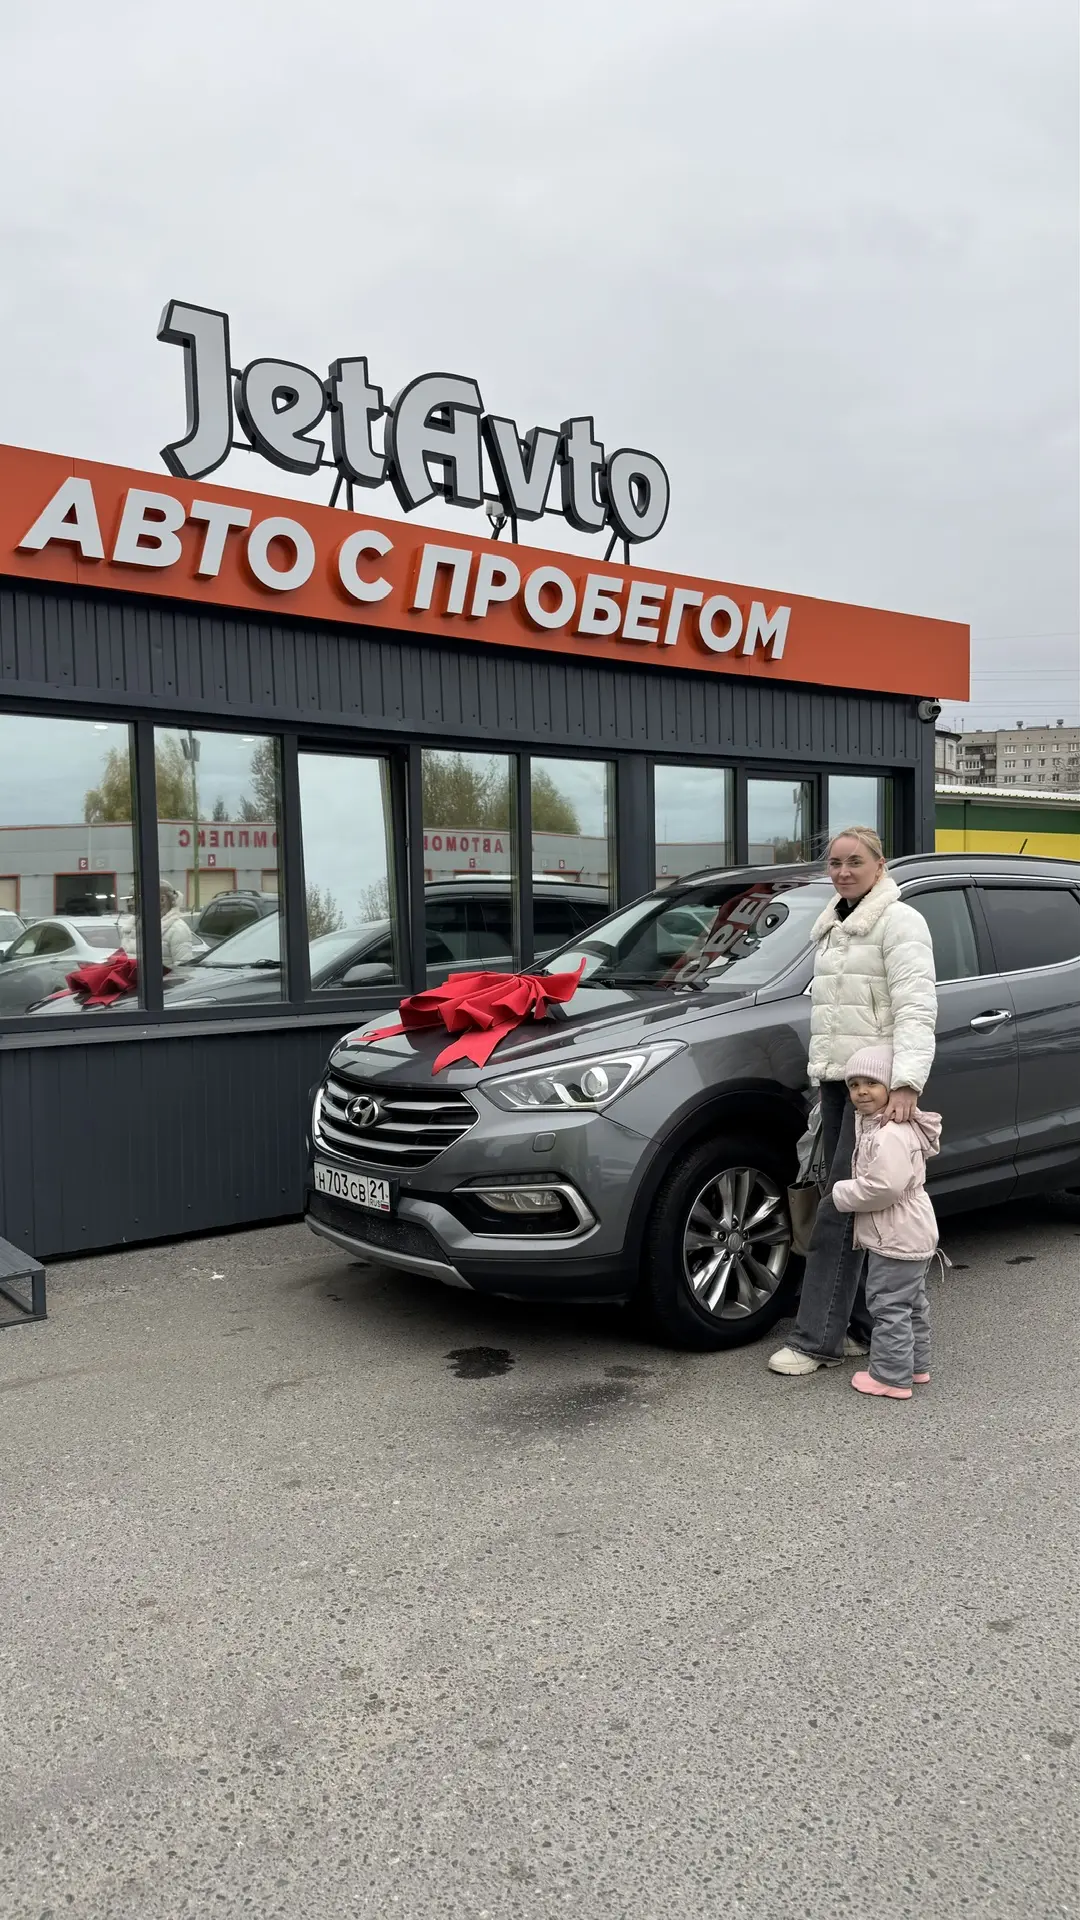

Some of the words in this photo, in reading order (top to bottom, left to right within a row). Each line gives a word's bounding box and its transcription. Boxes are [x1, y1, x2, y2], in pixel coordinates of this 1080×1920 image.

[157, 299, 670, 545] JetAvto
[18, 476, 316, 592] АВТО
[337, 529, 394, 603] С
[411, 543, 792, 661] ПРОБЕГОМ
[369, 1180, 384, 1200] 21
